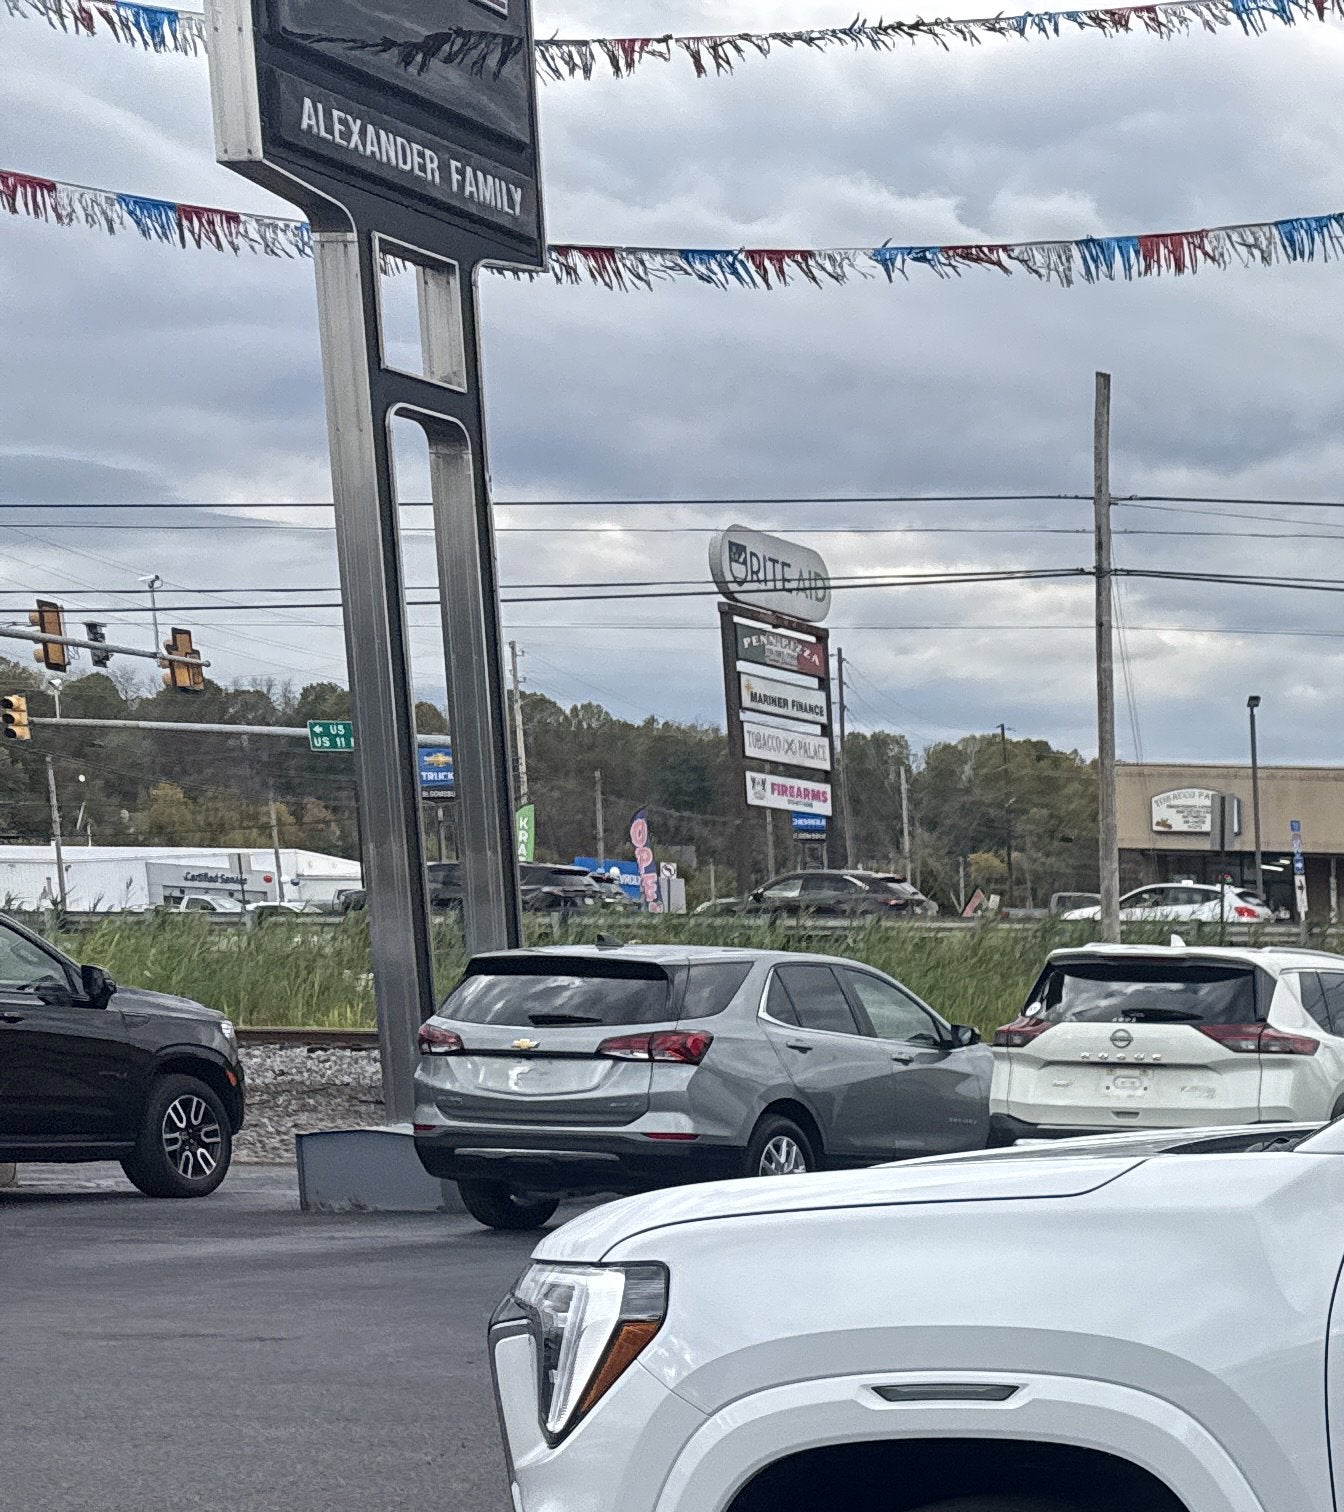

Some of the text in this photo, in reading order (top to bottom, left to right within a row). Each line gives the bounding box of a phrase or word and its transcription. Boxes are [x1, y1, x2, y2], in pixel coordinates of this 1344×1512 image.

[301, 97, 522, 216] ALEXANDER FAMILY
[750, 550, 827, 602] RITE AID
[743, 634, 777, 649] PENN
[750, 691, 825, 718] MARINER FINANCE
[313, 737, 331, 747] US
[329, 725, 345, 735] US
[746, 729, 828, 762] TOBACCO PALACE
[770, 782, 829, 804] FIREARMS
[518, 816, 530, 861] KRA
